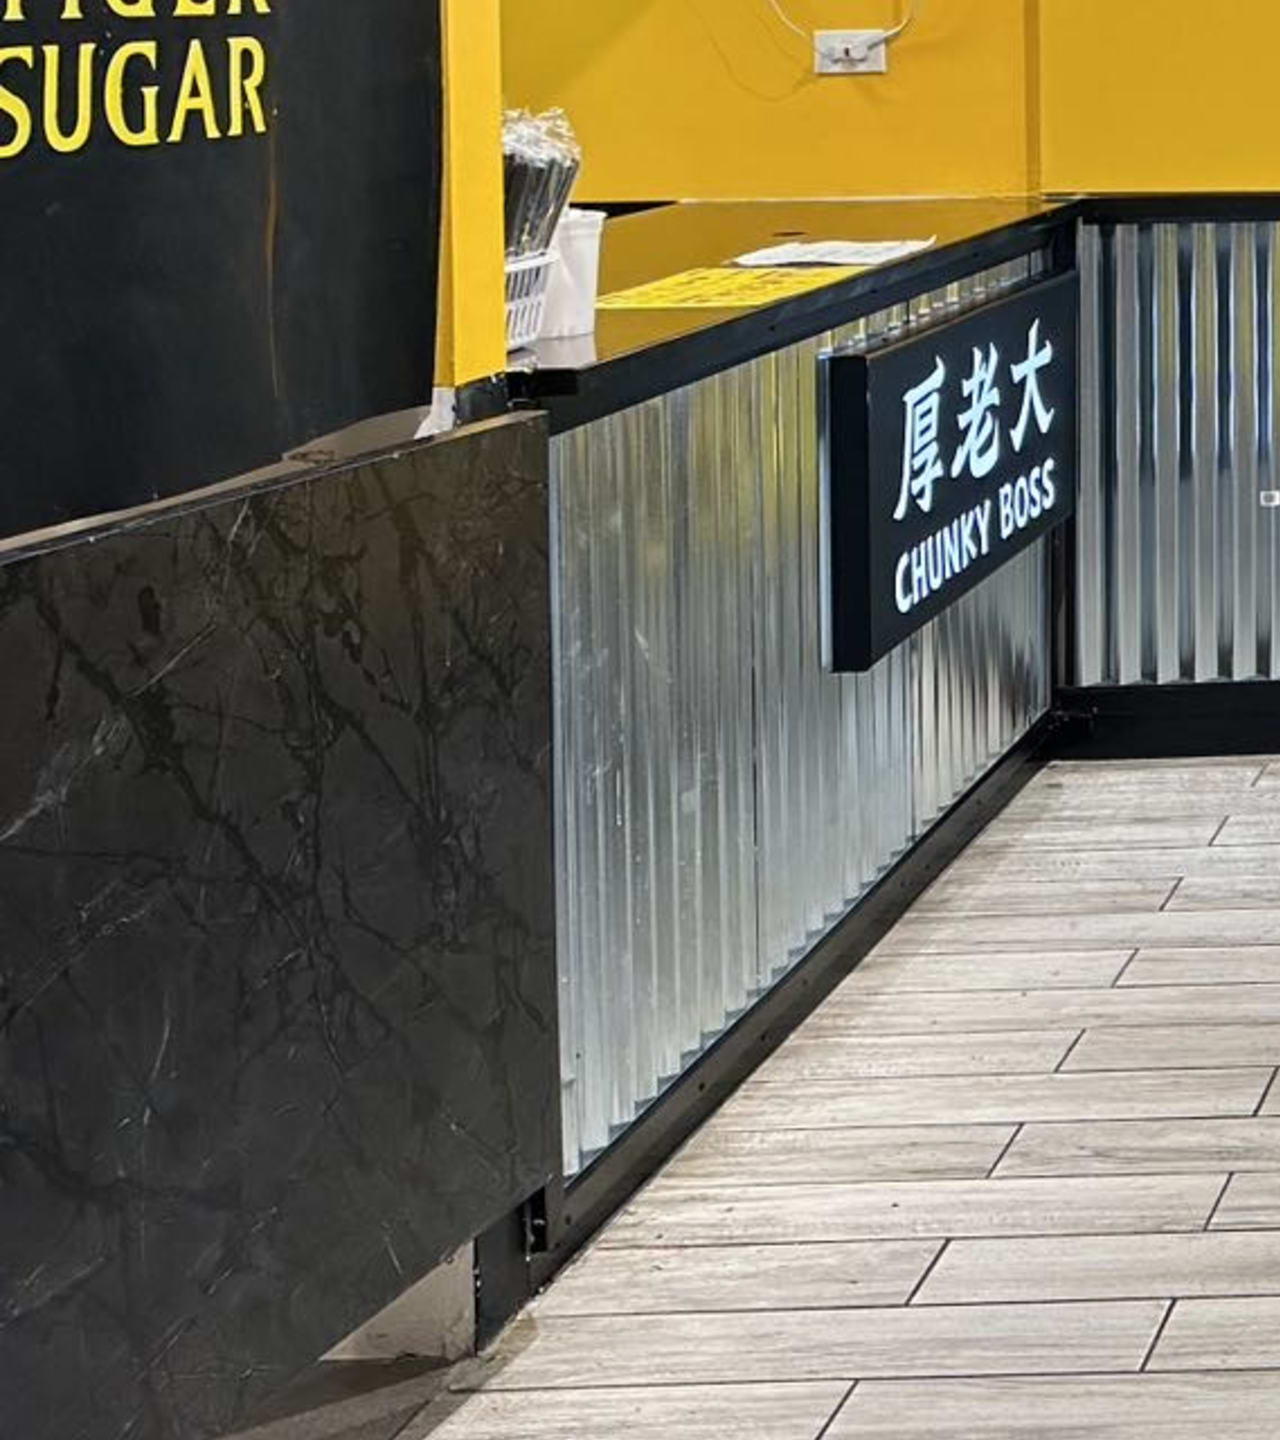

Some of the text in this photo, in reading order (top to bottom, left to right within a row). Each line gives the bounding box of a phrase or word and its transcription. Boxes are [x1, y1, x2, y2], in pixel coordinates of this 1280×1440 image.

[0, 35, 268, 160] SUGAR
[893, 318, 1056, 522] 厚老大
[894, 458, 1057, 615] CHUNKY BOSS
